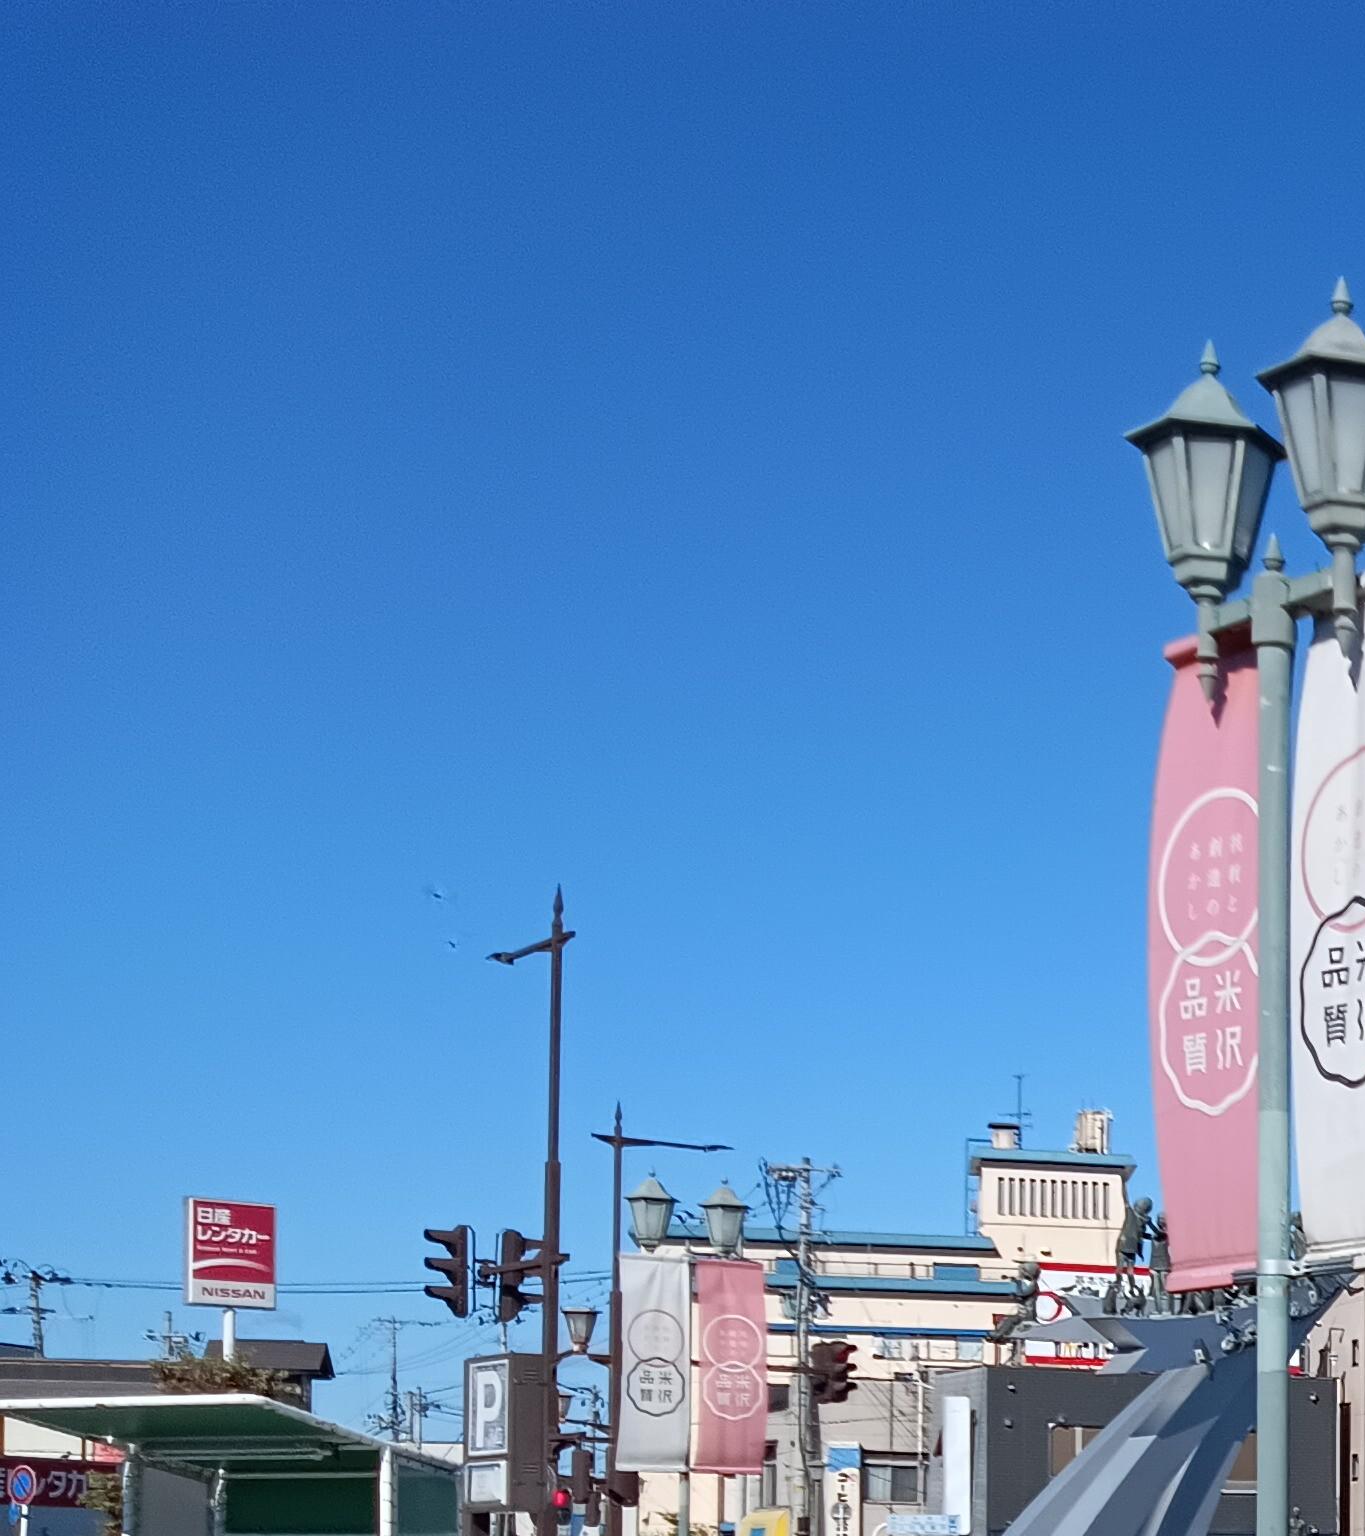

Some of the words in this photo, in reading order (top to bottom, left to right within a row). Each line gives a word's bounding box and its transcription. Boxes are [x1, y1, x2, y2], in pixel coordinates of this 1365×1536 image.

[197, 1207, 231, 1226] 日産
[196, 1224, 271, 1245] レンタカー
[201, 1286, 266, 1300] NISSAN
[475, 1370, 501, 1448] P
